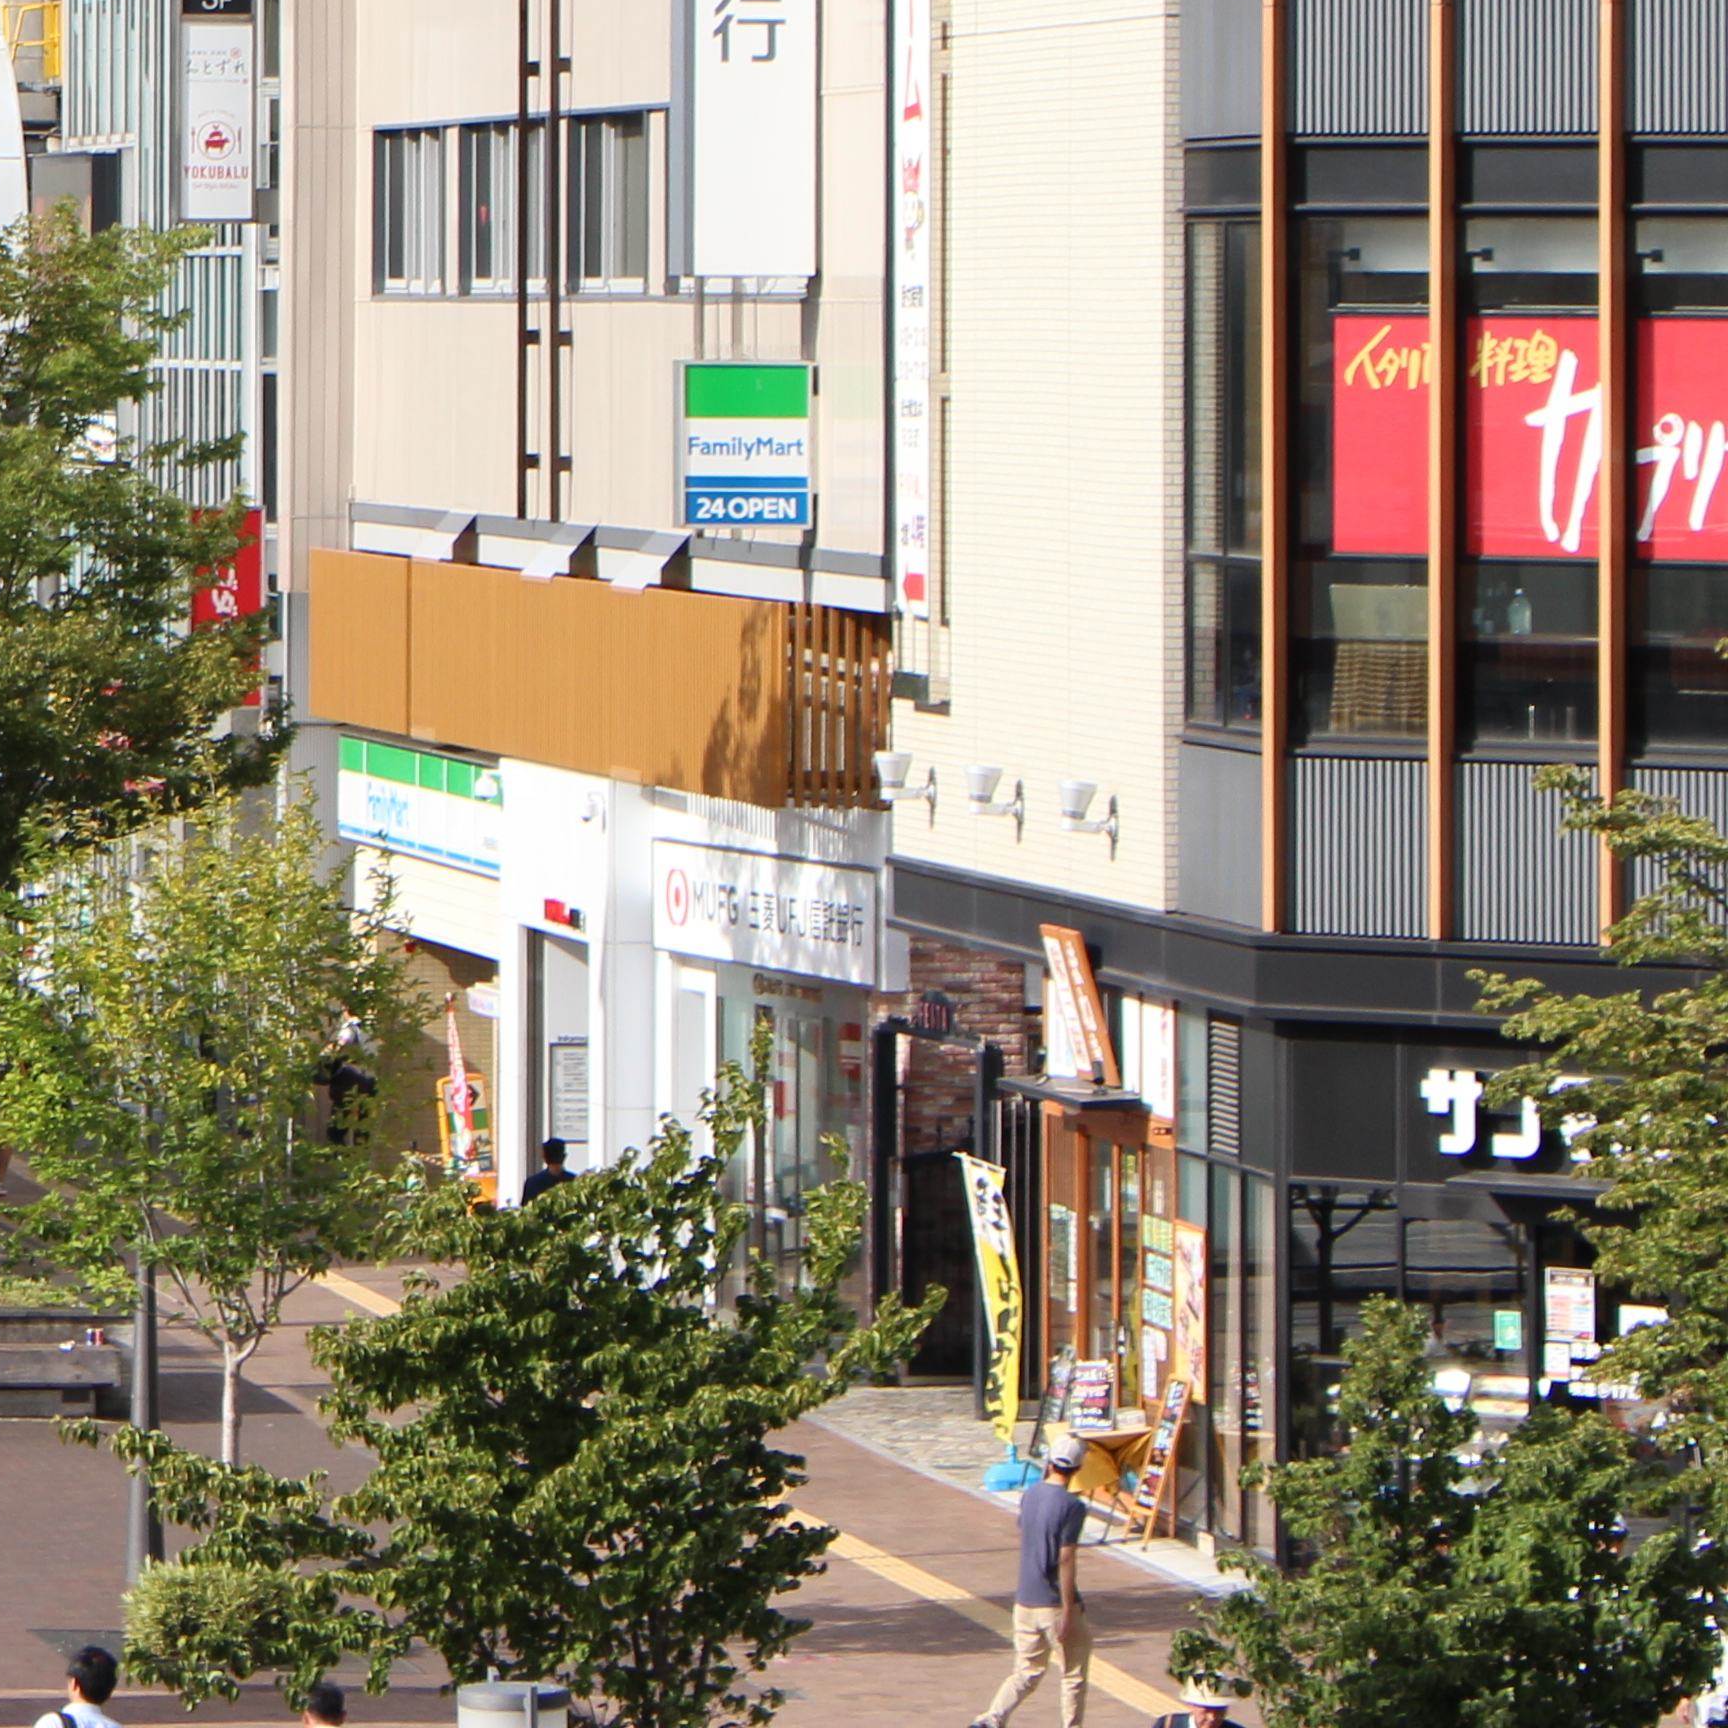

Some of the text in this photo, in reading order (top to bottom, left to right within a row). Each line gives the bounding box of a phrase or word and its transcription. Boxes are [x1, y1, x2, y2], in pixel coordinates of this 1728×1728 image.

[1344, 324, 1559, 392] イタリ料理
[687, 436, 805, 461] FamilyMart
[366, 779, 410, 831] FamilyMart
[691, 882, 864, 949] MUFG 三菱UFJ信託銀行
